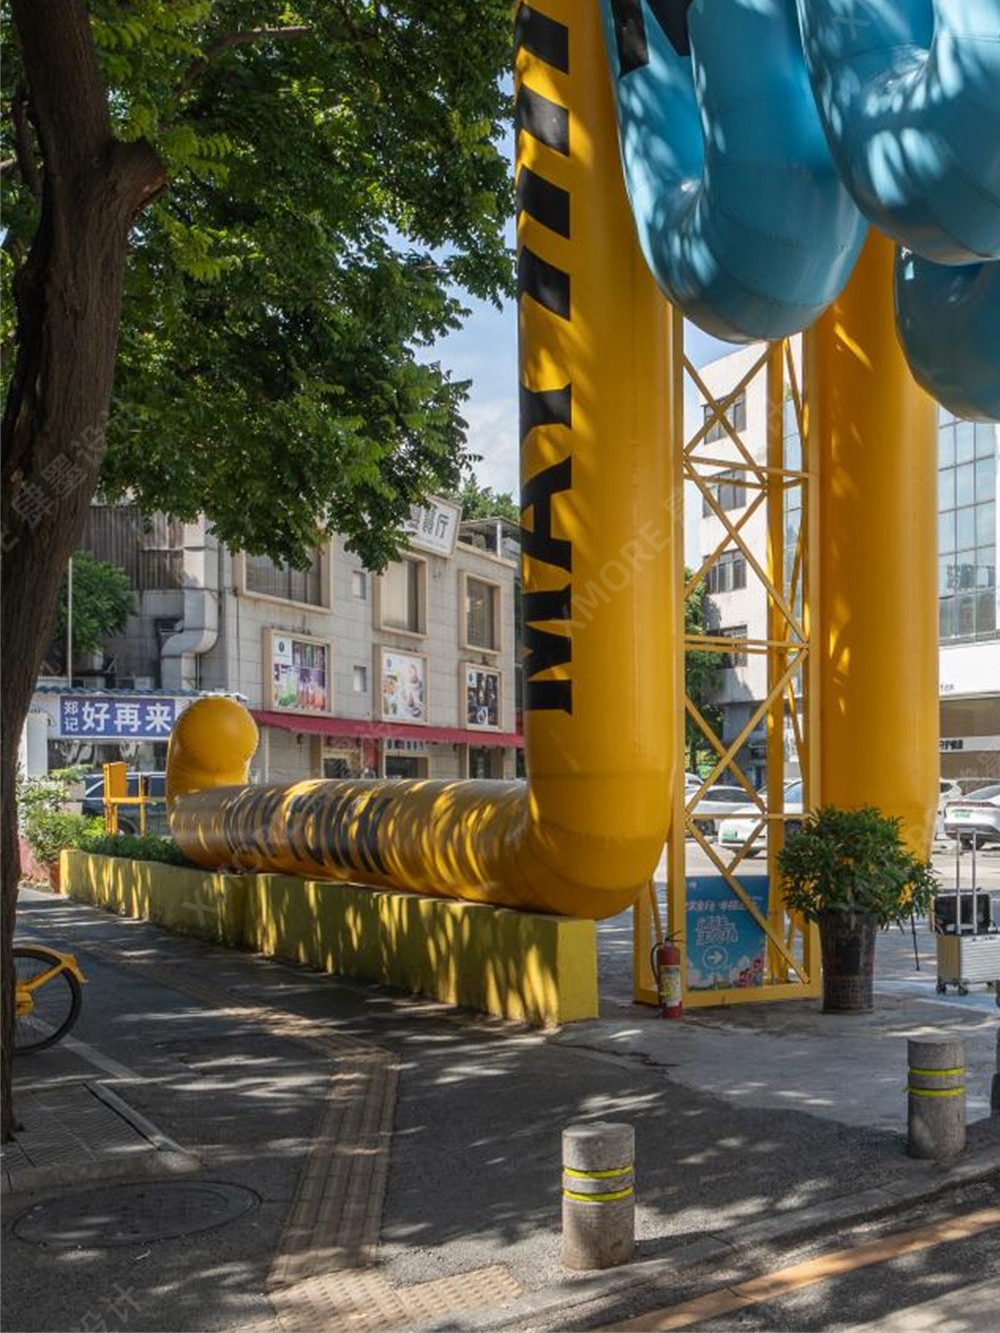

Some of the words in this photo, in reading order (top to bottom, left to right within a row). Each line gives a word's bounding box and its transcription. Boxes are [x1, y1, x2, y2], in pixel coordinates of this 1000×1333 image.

[64, 700, 79, 733] 郑记
[82, 701, 172, 733] 好再来
